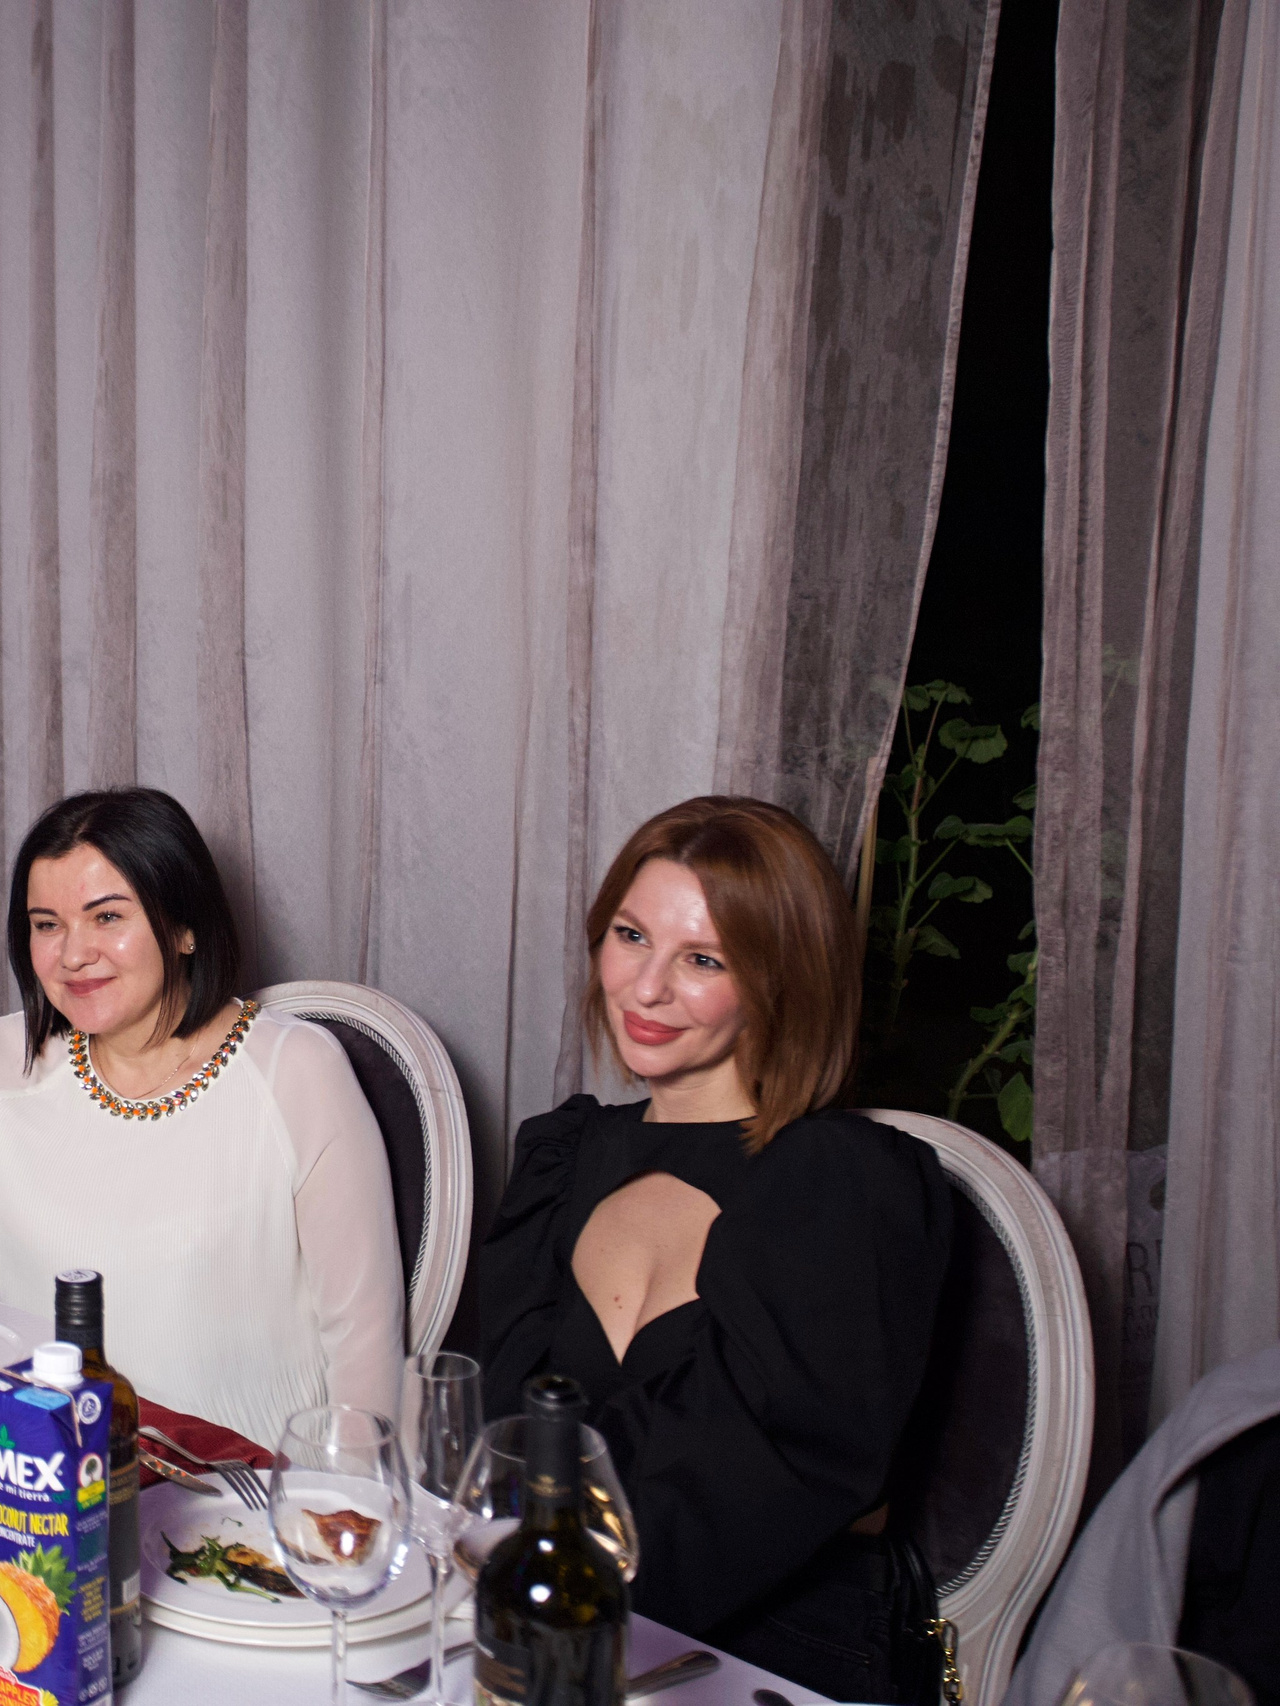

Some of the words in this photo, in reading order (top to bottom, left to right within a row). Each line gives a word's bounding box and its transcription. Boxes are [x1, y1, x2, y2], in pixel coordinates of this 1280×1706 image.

[5, 1483, 17, 1495] mi
[18, 1487, 50, 1503] tierra
[29, 1512, 70, 1537] NECTAR
